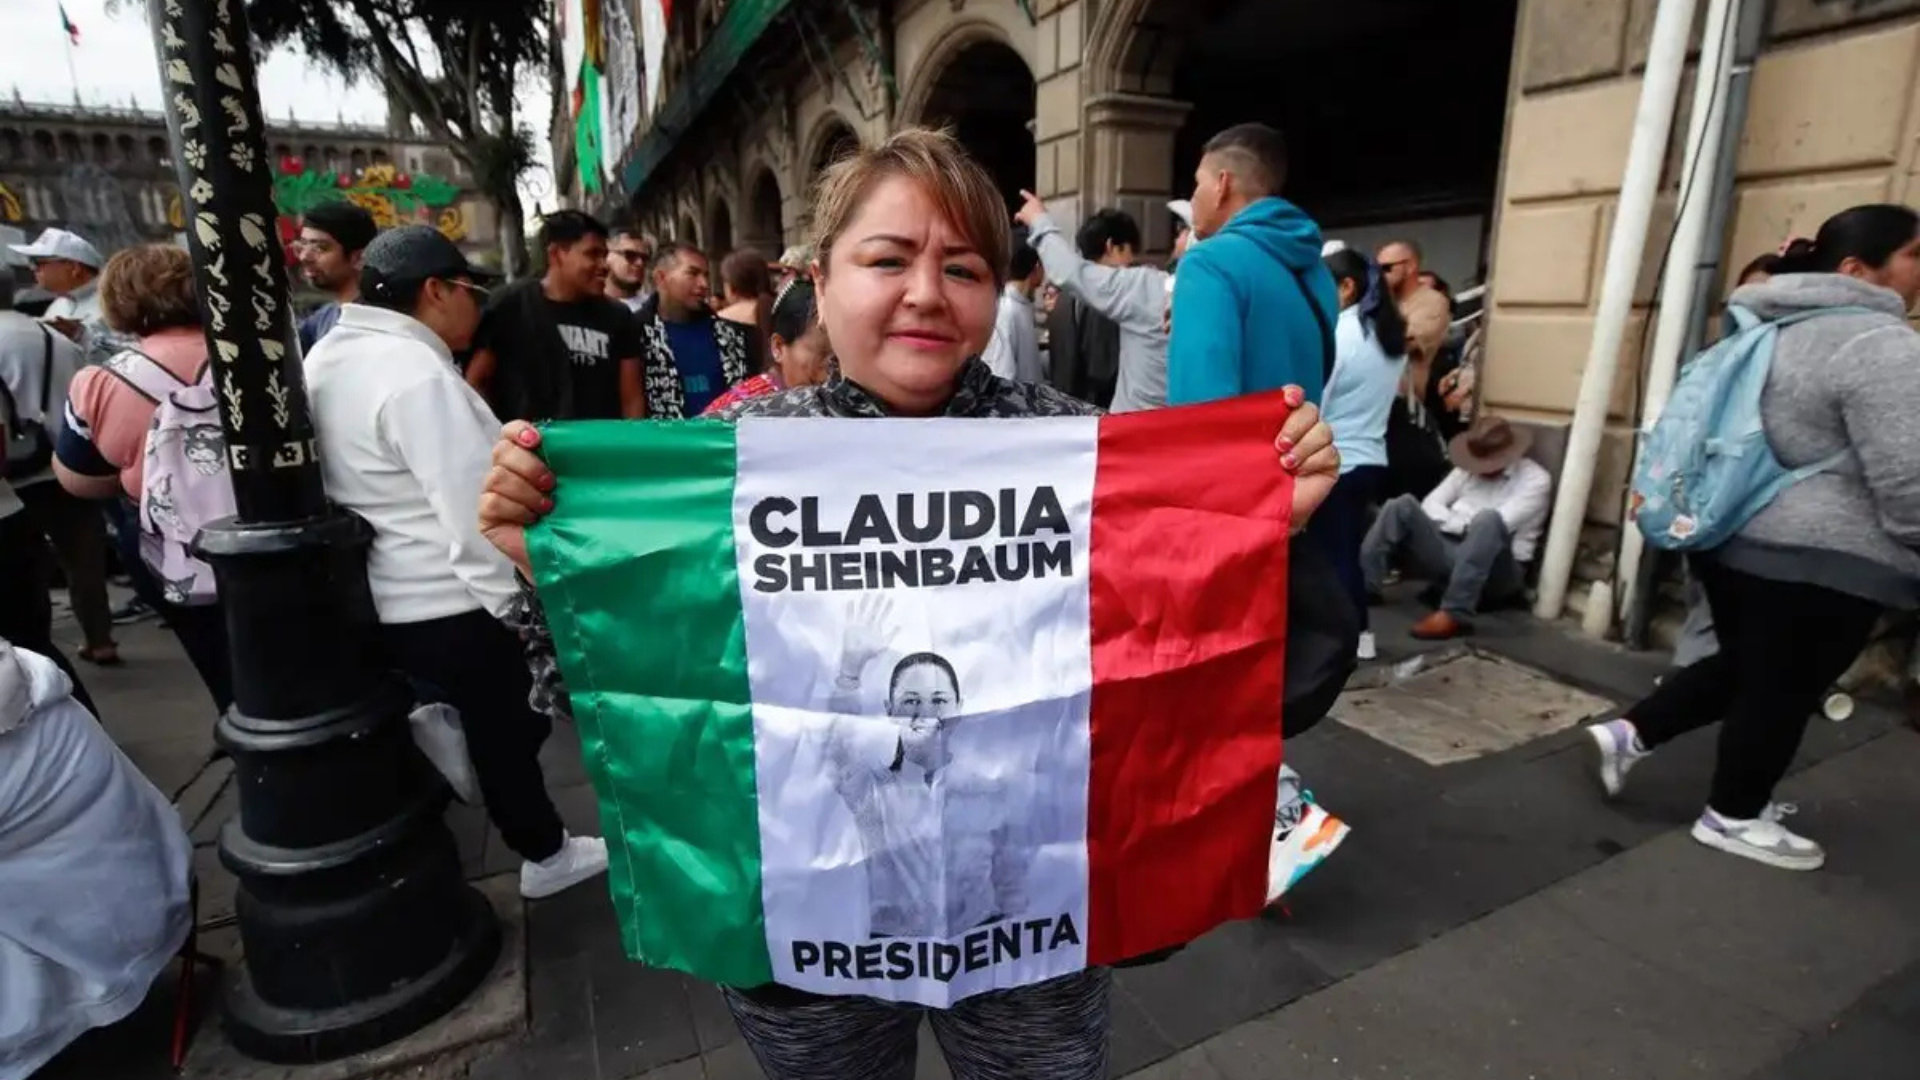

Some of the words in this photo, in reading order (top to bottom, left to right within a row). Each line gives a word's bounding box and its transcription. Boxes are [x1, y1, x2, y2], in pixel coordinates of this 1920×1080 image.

[750, 486, 1071, 548] CLAUDIA
[753, 540, 1073, 593] SHEINBAUM
[792, 913, 1080, 983] PRESIDENTA
